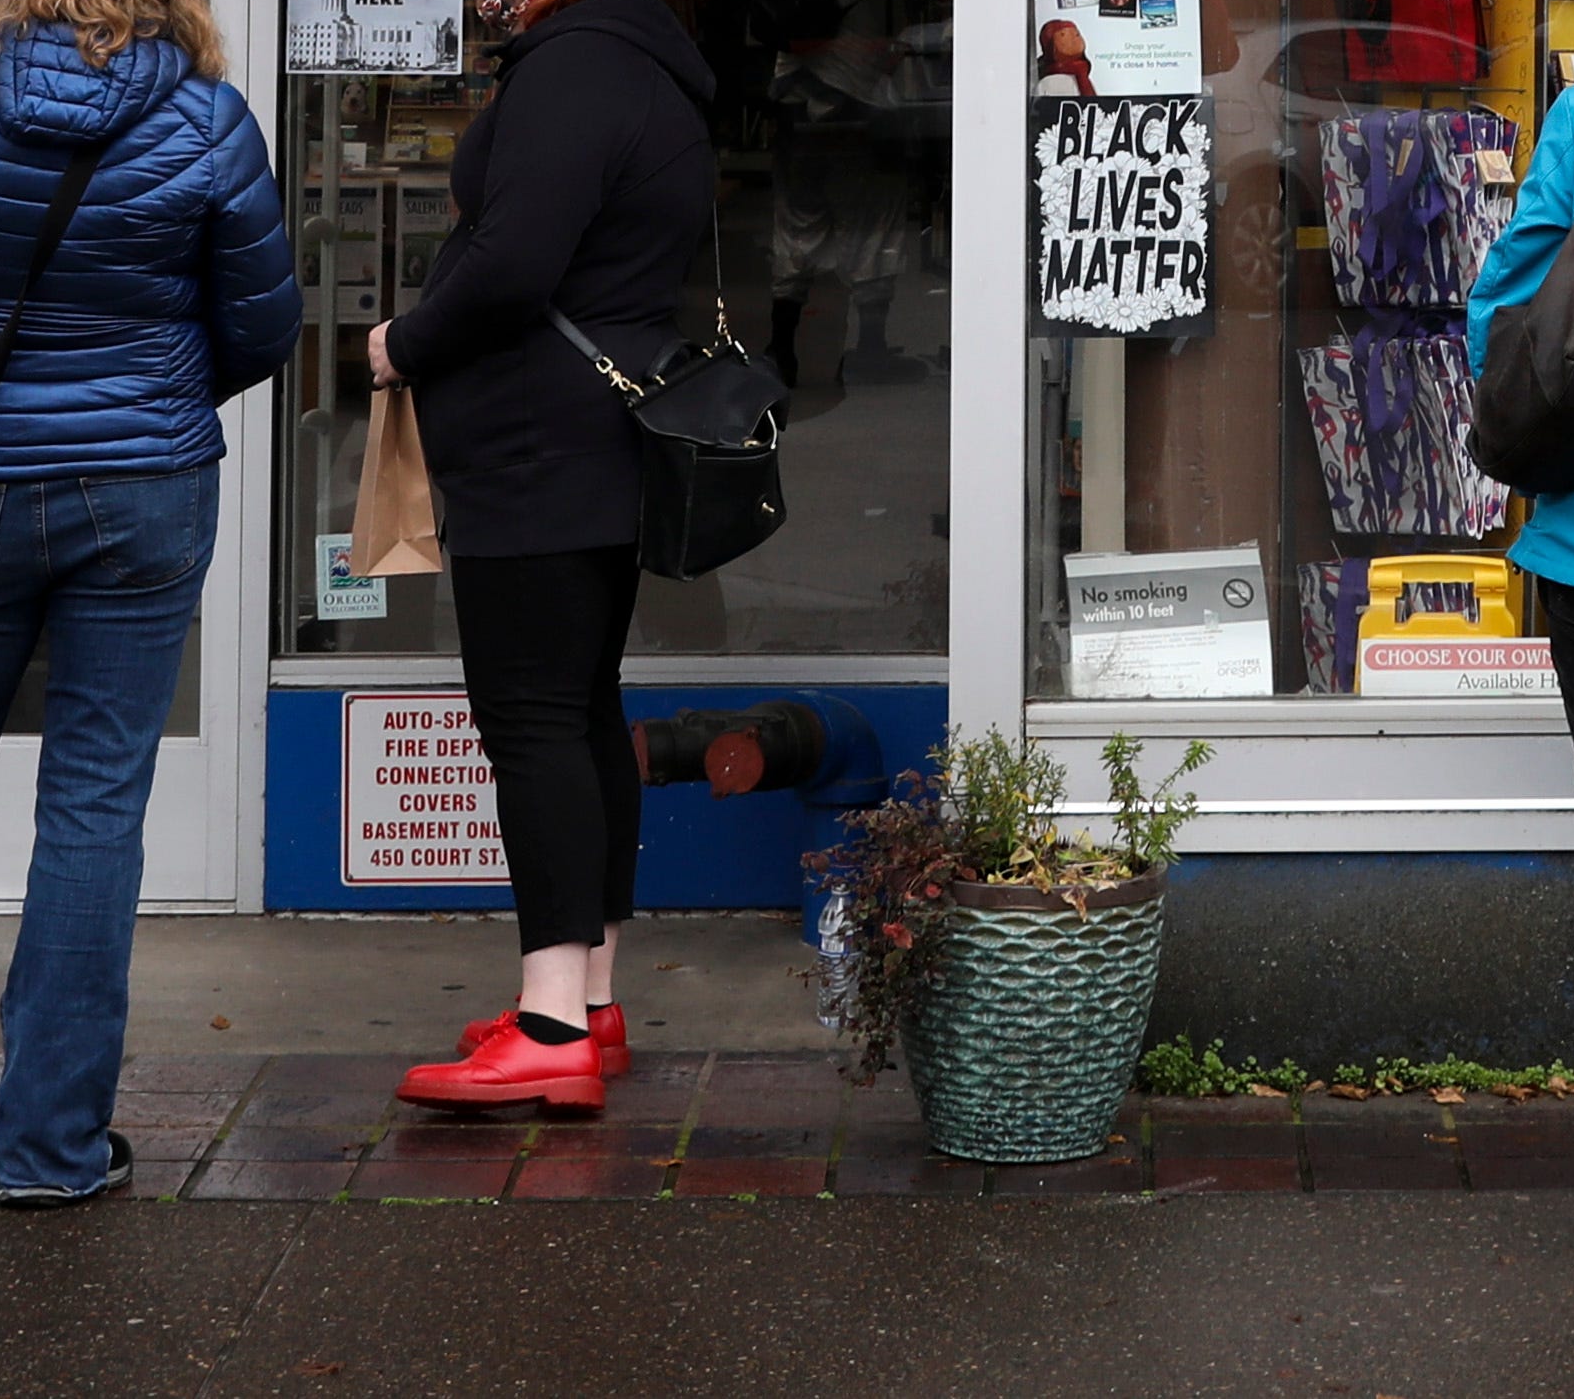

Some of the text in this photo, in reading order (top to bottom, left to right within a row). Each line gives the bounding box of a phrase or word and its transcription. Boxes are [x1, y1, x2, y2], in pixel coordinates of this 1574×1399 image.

[1147, 43, 1166, 52] your
[1057, 99, 1203, 166] BLACK
[1068, 167, 1184, 233] LIVES
[1043, 236, 1204, 305] MATTER
[1081, 581, 1187, 604] No smoking
[1083, 603, 1174, 622] within 10 feet
[1375, 649, 1506, 665] CHOOSE YOUR
[1457, 673, 1534, 689] Available
[385, 740, 428, 757] FIRE
[399, 794, 477, 812] COVERS
[363, 822, 459, 840] BASEMENT
[370, 849, 506, 866] 450 COURT ST.
